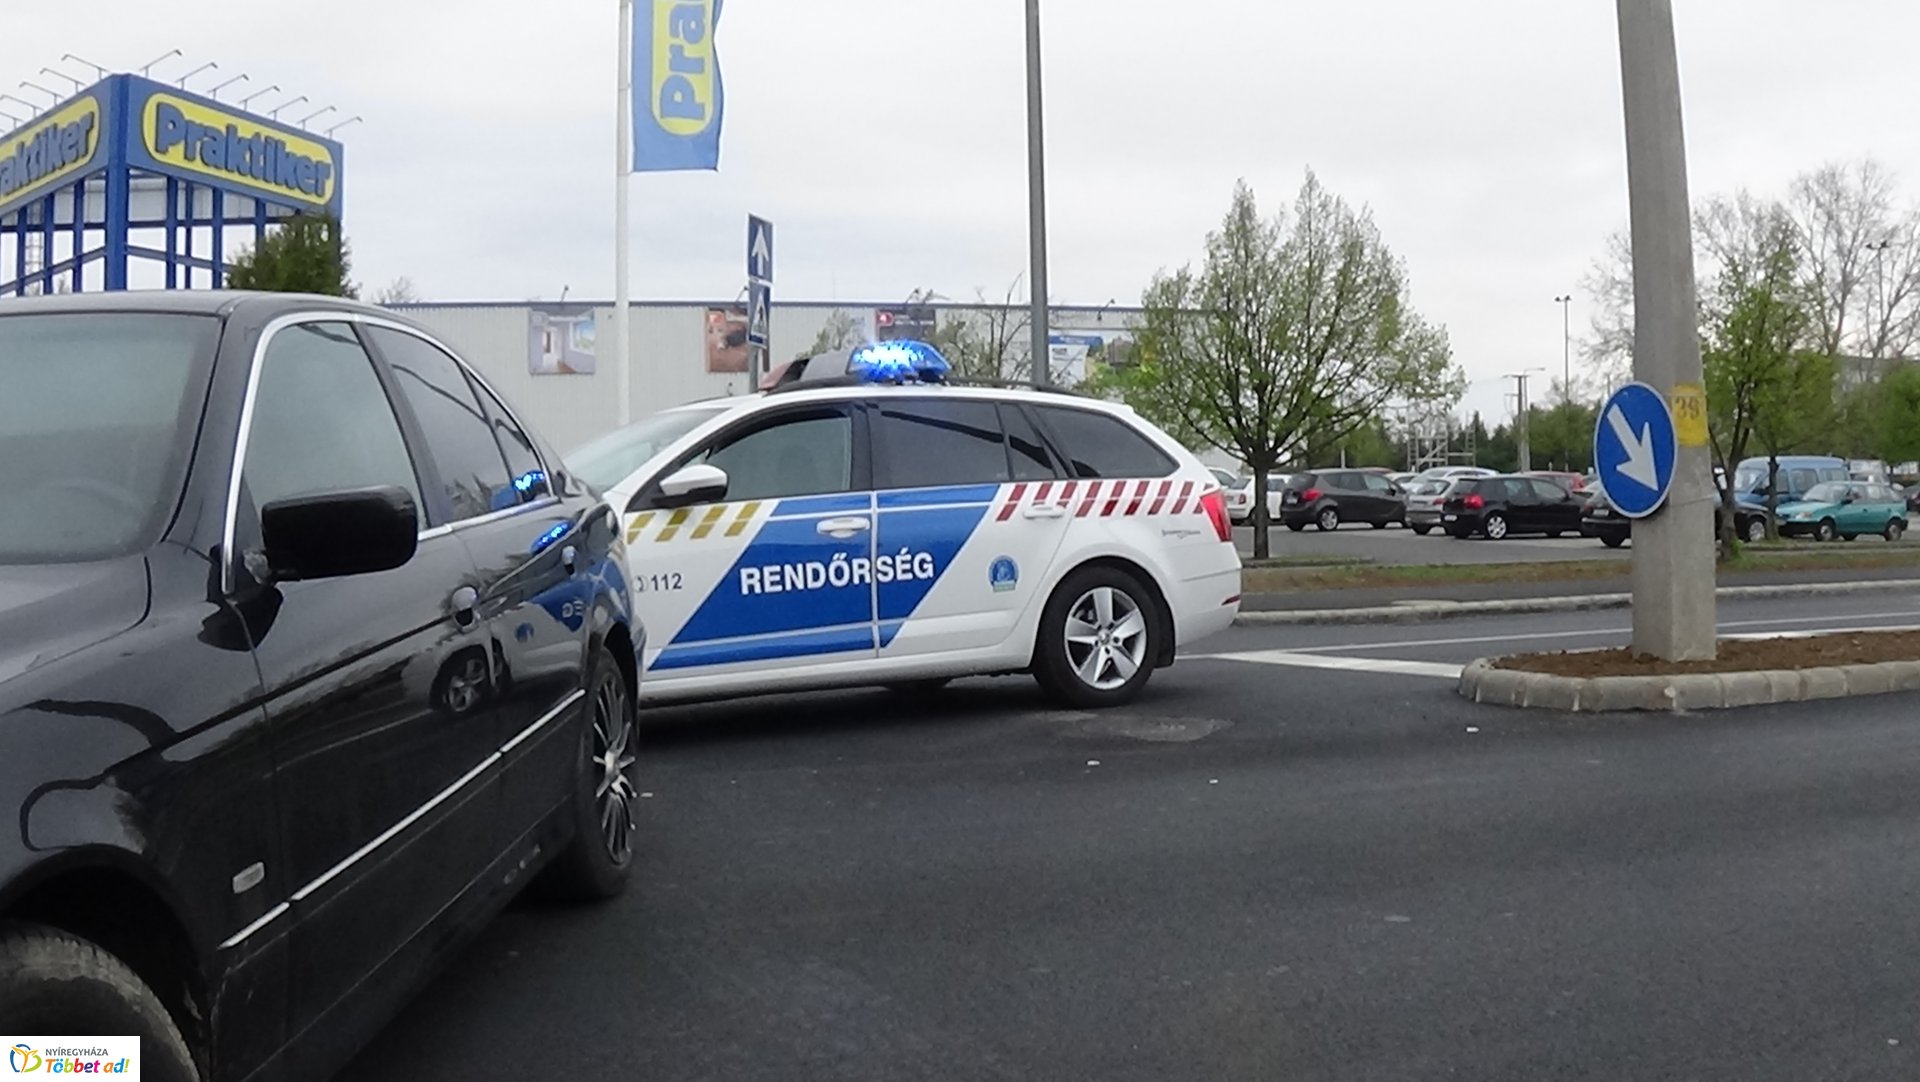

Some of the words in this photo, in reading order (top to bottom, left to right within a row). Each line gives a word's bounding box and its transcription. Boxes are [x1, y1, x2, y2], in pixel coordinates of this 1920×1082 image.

[154, 101, 332, 198] Praktiker
[650, 572, 683, 592] 112
[739, 547, 935, 596] RENDŐRSÉG
